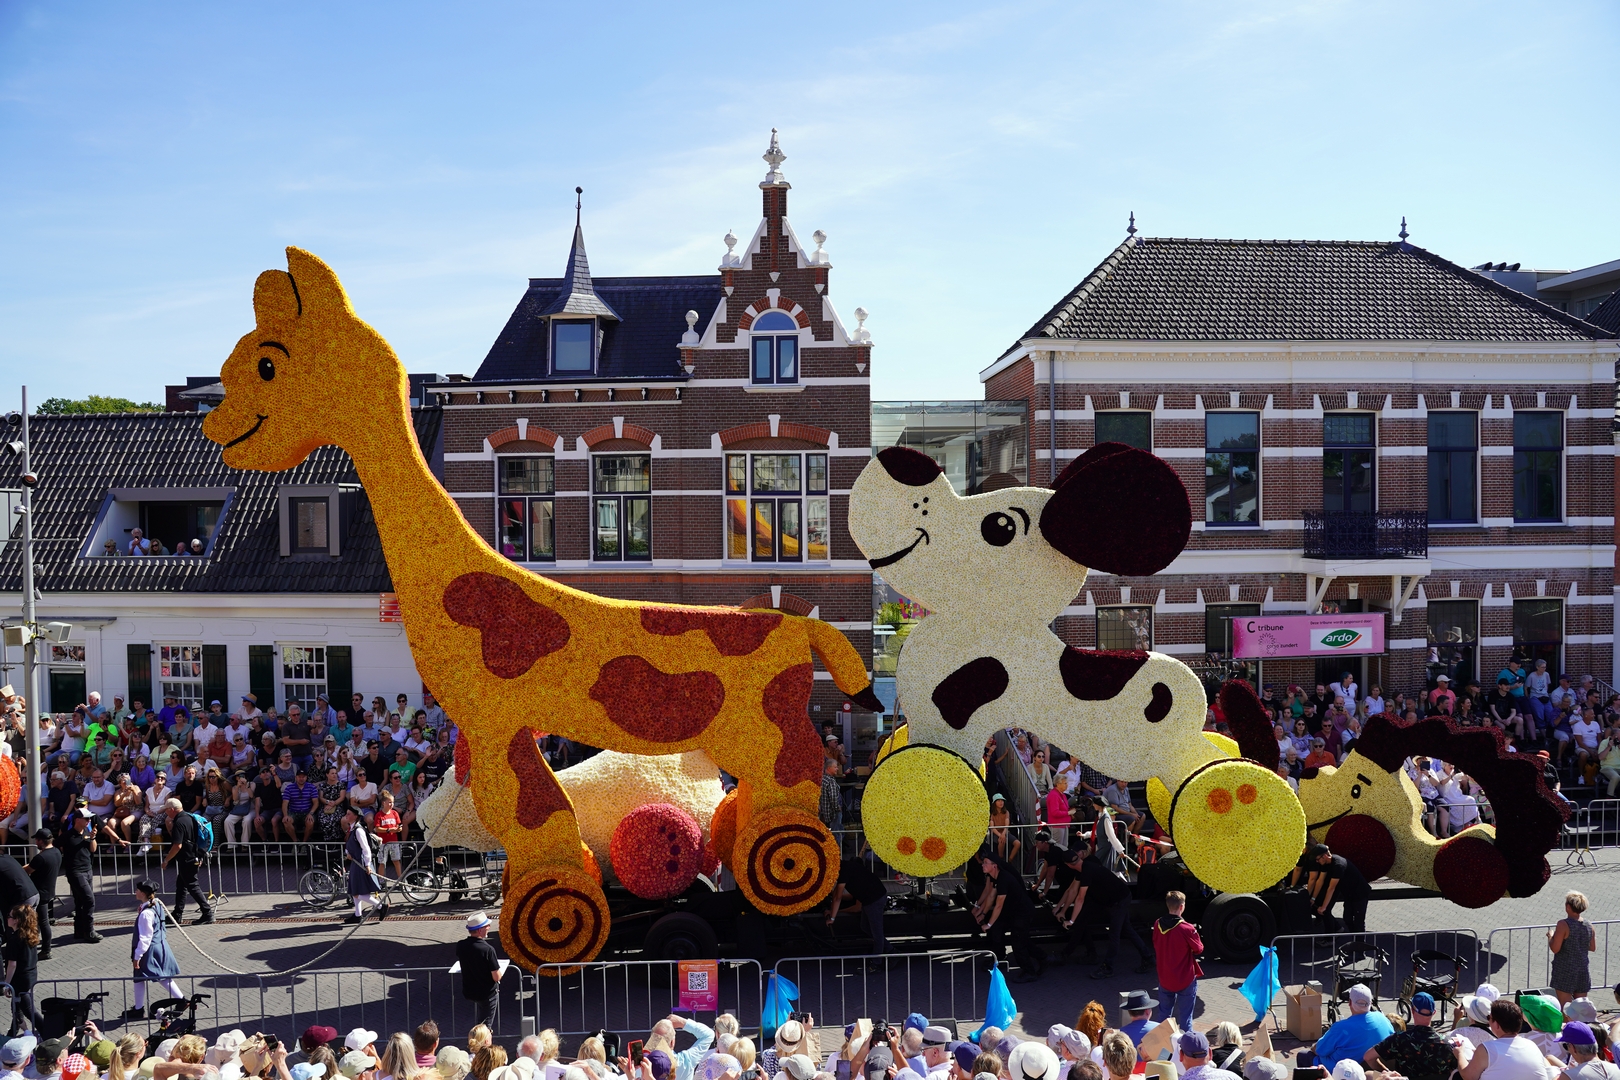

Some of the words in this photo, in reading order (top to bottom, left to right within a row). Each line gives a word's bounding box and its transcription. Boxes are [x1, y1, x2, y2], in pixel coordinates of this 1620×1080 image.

[1246, 620, 1256, 633] C
[1326, 632, 1352, 642] ardo
[414, 791, 424, 799] USA
